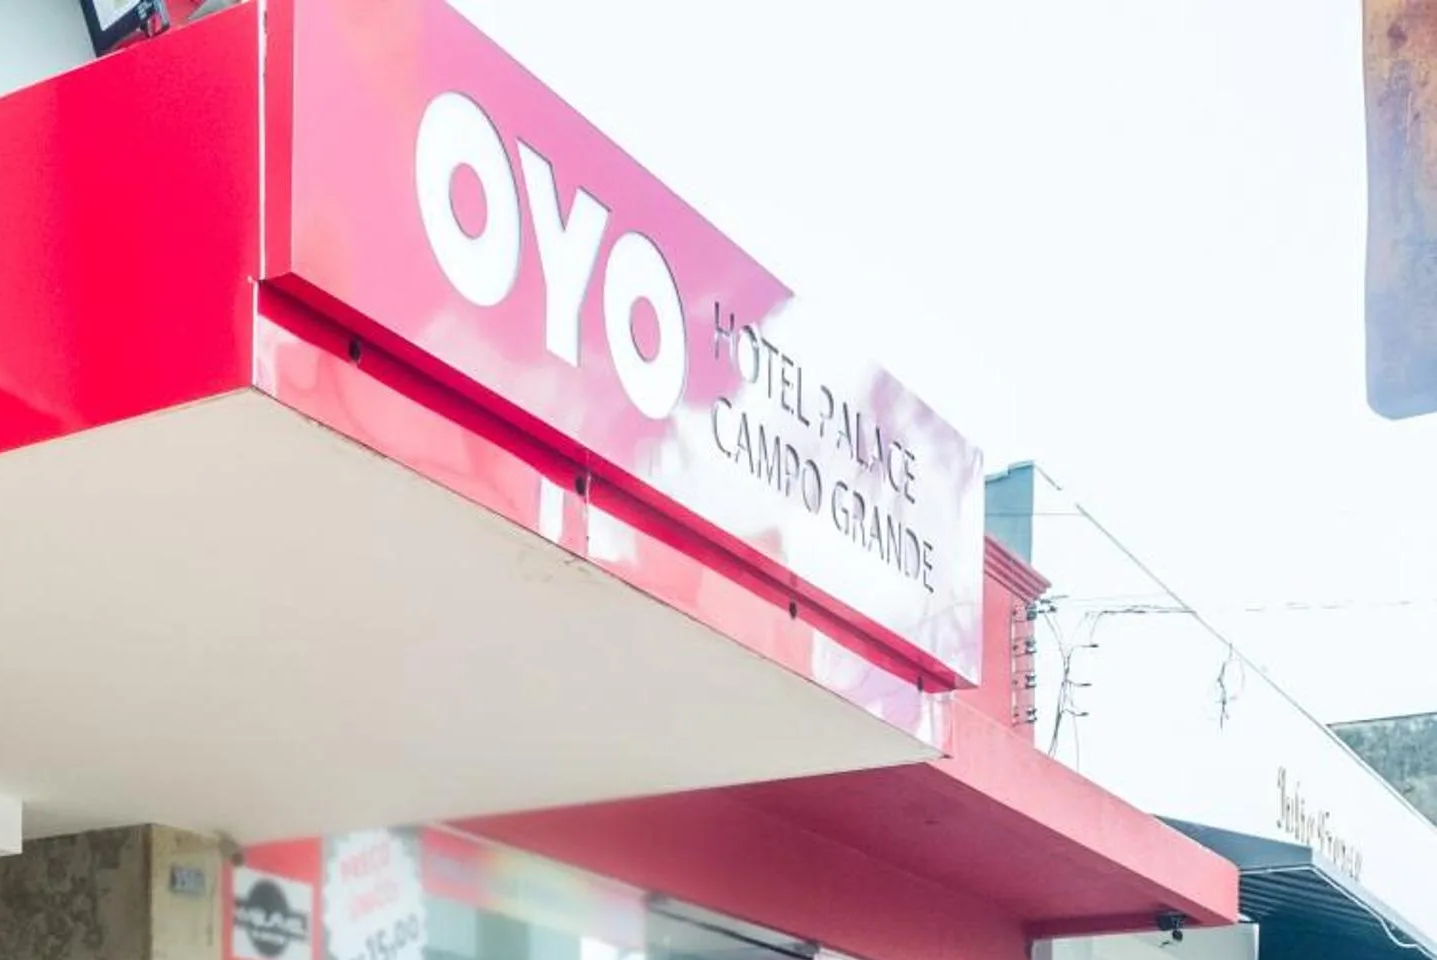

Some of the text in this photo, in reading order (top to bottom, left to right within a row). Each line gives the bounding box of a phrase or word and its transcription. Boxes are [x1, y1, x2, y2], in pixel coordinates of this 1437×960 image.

[415, 91, 687, 421] OYO
[711, 396, 935, 594] CAMPO GRANDE
[714, 300, 916, 504] HOTEL PALACE
